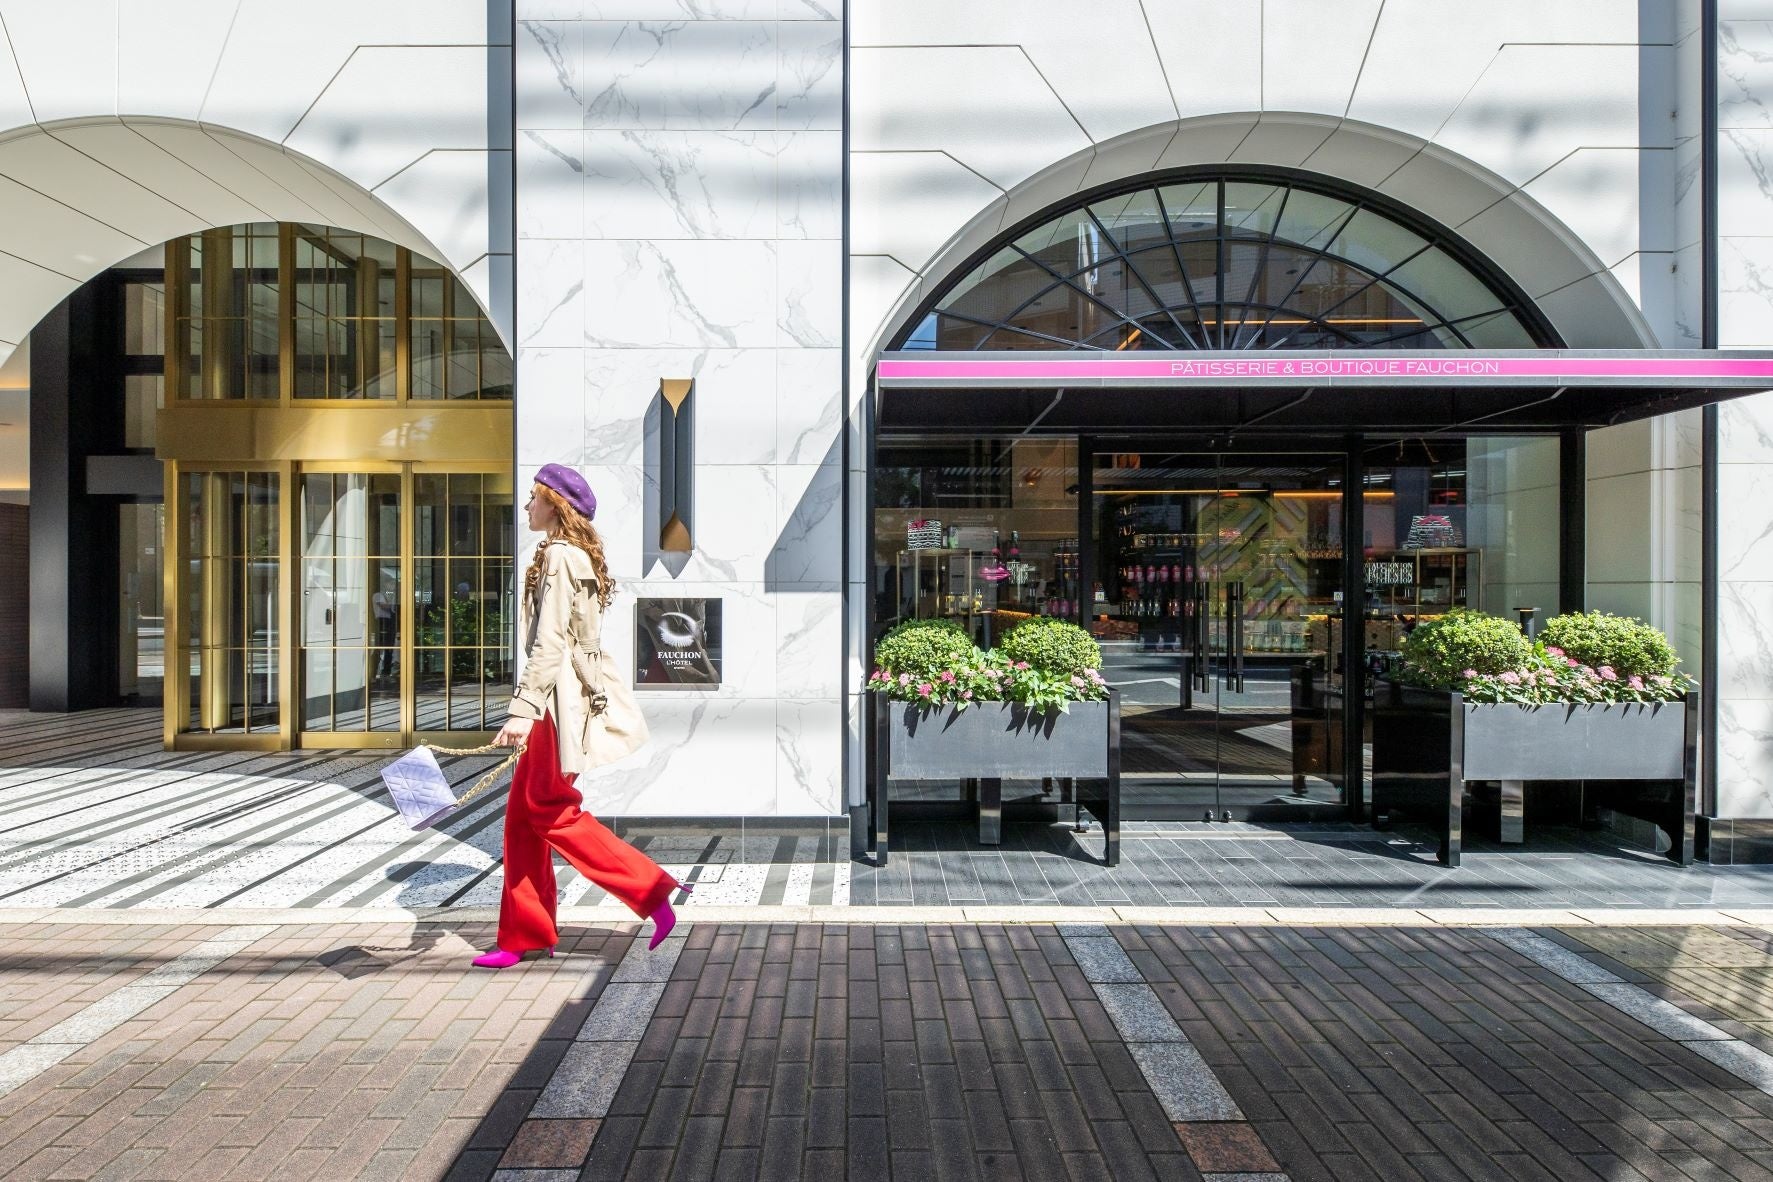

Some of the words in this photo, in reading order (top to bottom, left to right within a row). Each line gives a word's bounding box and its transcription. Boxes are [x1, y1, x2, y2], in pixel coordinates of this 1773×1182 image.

[1171, 360, 1278, 375] PÂTISSERIE
[1283, 361, 1295, 374] &
[1301, 360, 1400, 375] BOUTIQUE
[1406, 361, 1499, 373] FAUCHON
[657, 651, 702, 659] FAUCHON
